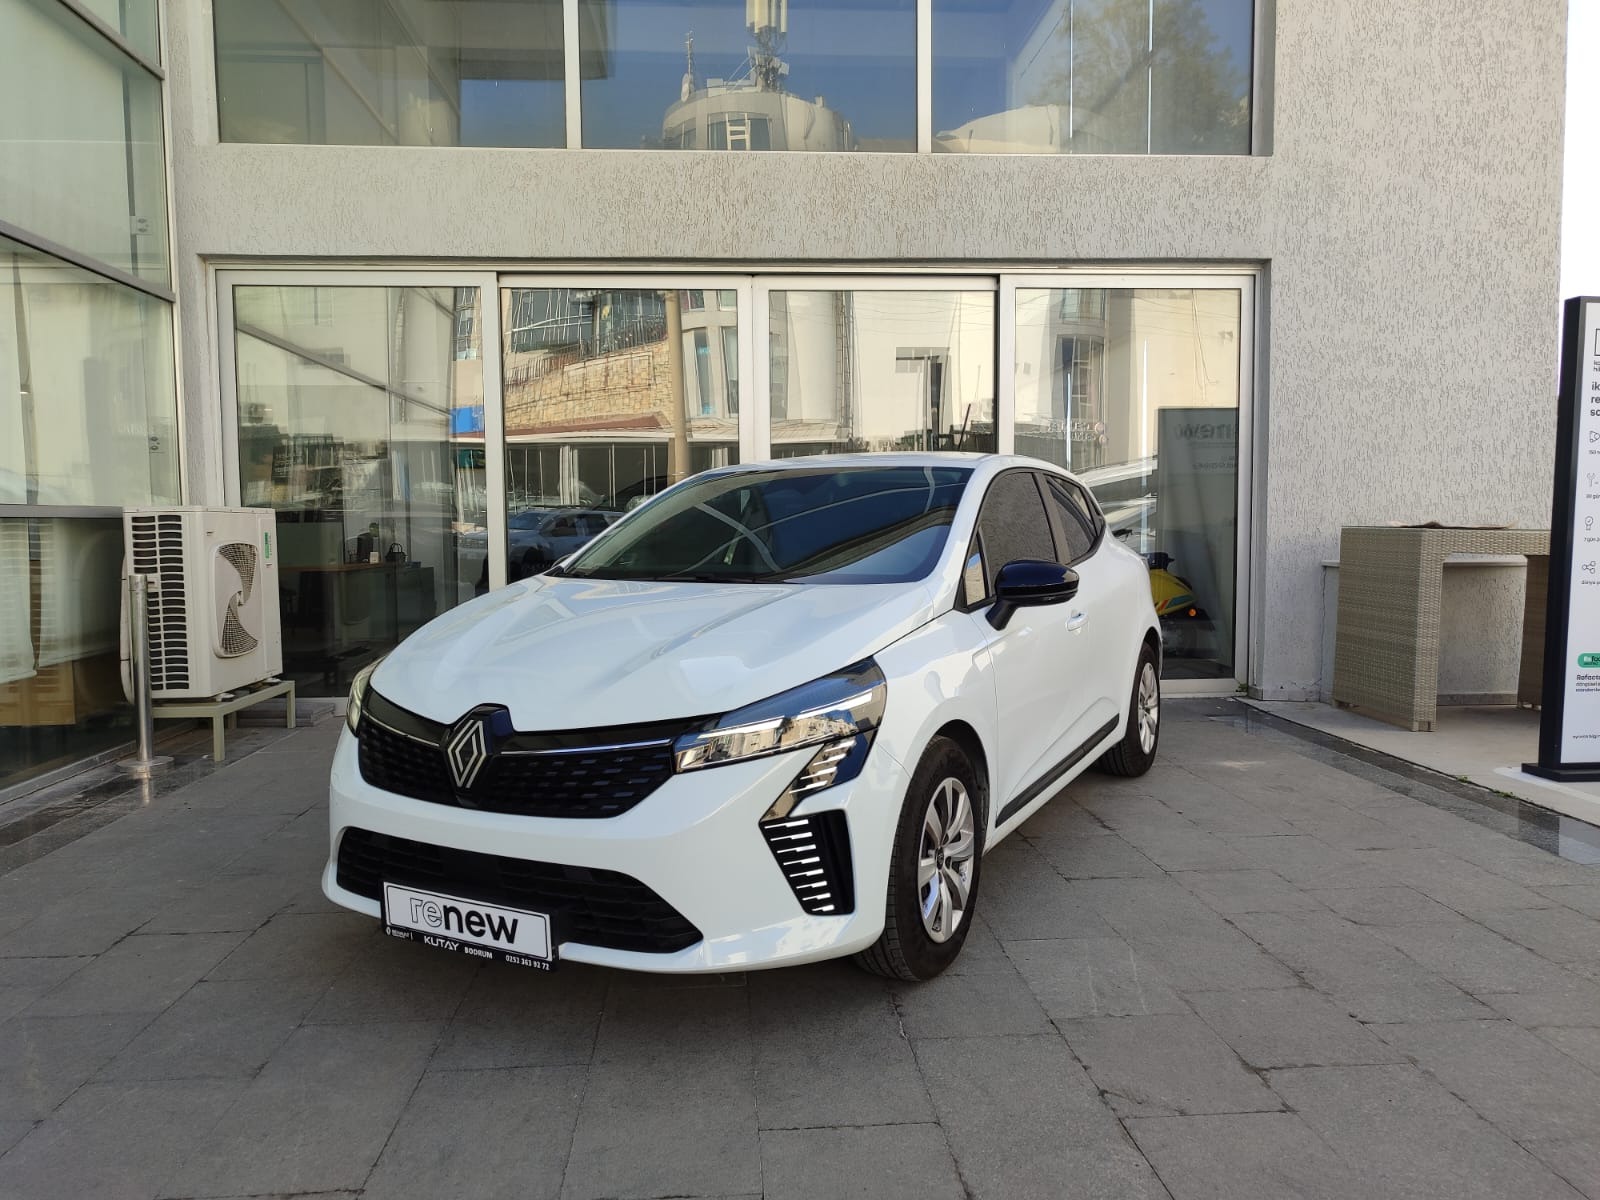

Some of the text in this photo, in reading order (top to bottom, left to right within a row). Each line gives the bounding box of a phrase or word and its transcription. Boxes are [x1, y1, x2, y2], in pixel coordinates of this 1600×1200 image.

[409, 898, 519, 944] renew
[424, 935, 460, 951] KUTAY
[464, 946, 493, 959] BODRUM
